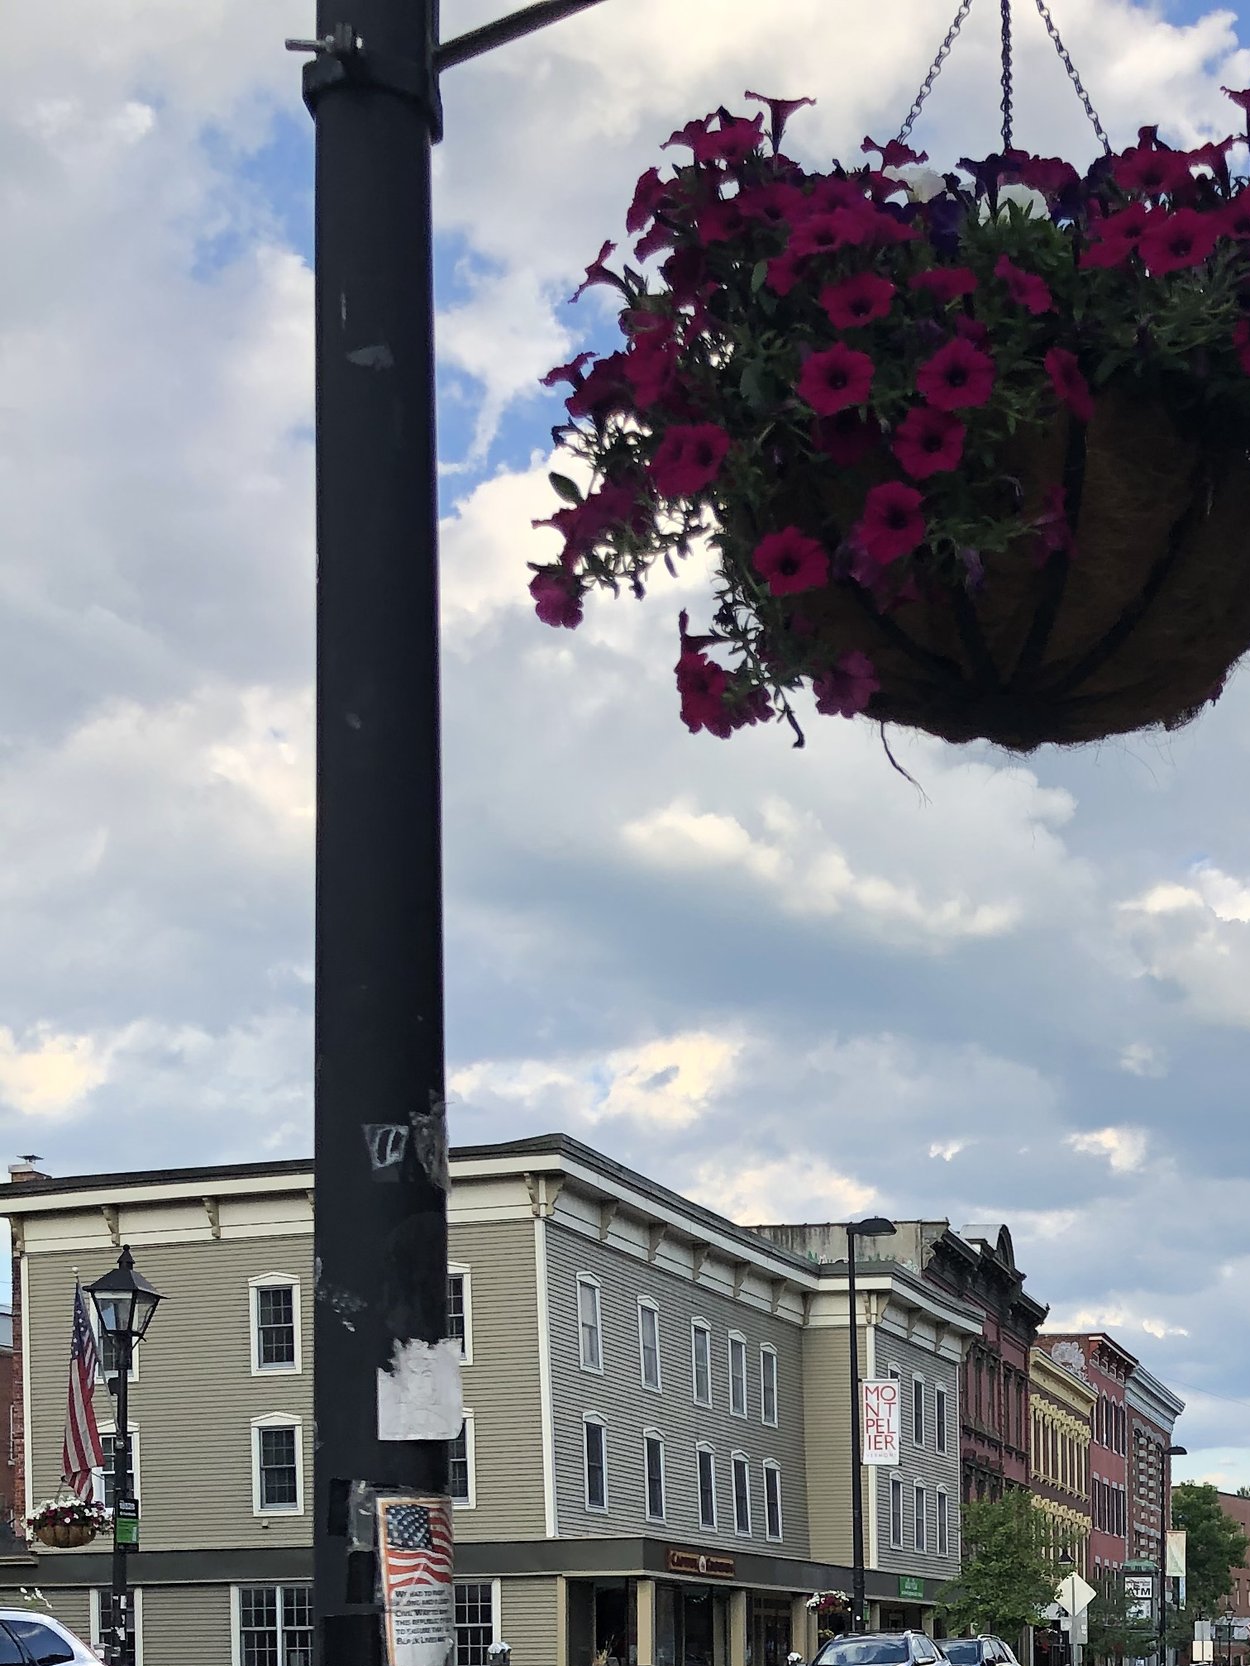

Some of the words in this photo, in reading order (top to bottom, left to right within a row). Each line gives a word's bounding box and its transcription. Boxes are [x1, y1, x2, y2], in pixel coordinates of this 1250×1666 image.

[865, 1386, 896, 1401] MO
[866, 1418, 896, 1434] PEL
[868, 1435, 896, 1450] IER
